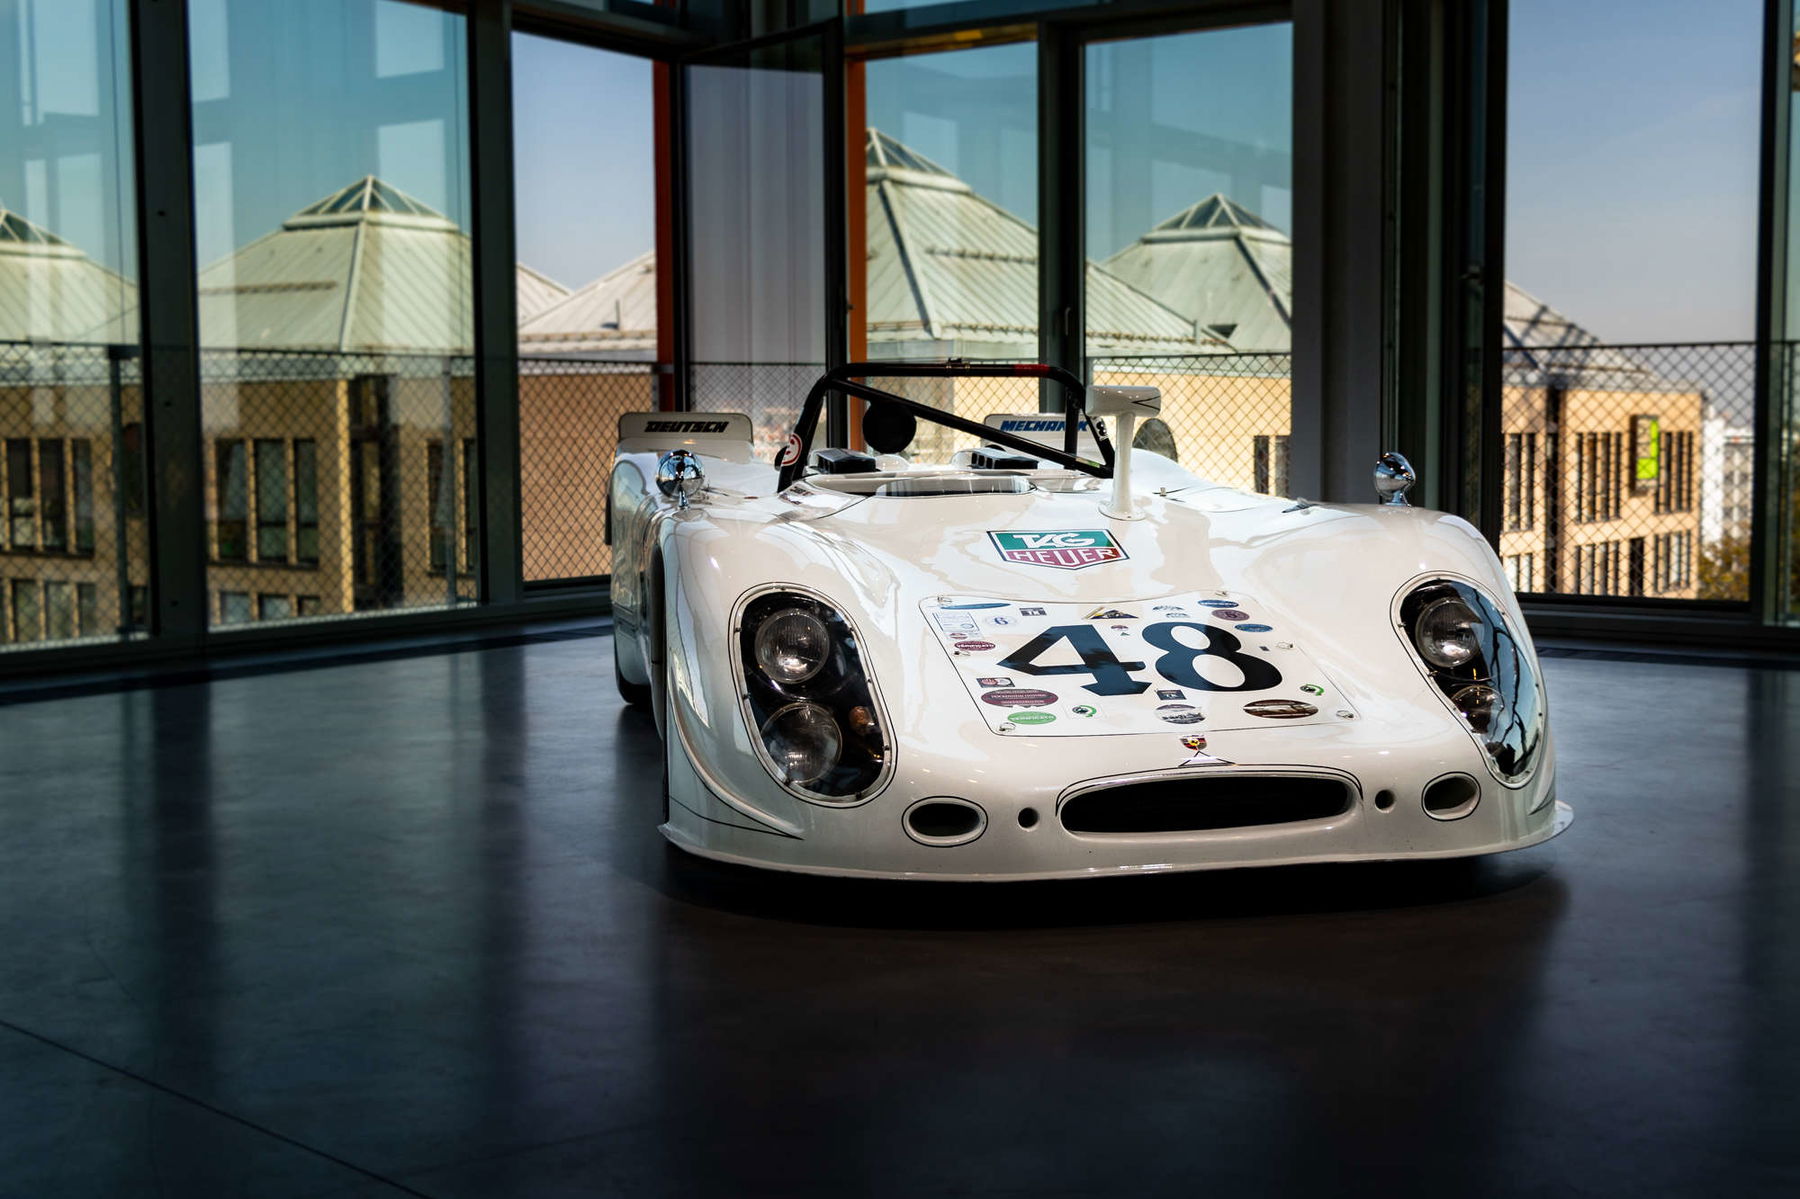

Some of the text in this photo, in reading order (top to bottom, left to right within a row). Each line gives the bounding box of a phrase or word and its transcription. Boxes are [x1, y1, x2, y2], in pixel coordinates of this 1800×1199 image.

[644, 421, 729, 433] DEUTSCH
[1000, 420, 1090, 432] MECHANK
[1013, 533, 1095, 549] TAG
[1013, 549, 1117, 566] HEUER
[997, 621, 1283, 696] 48
